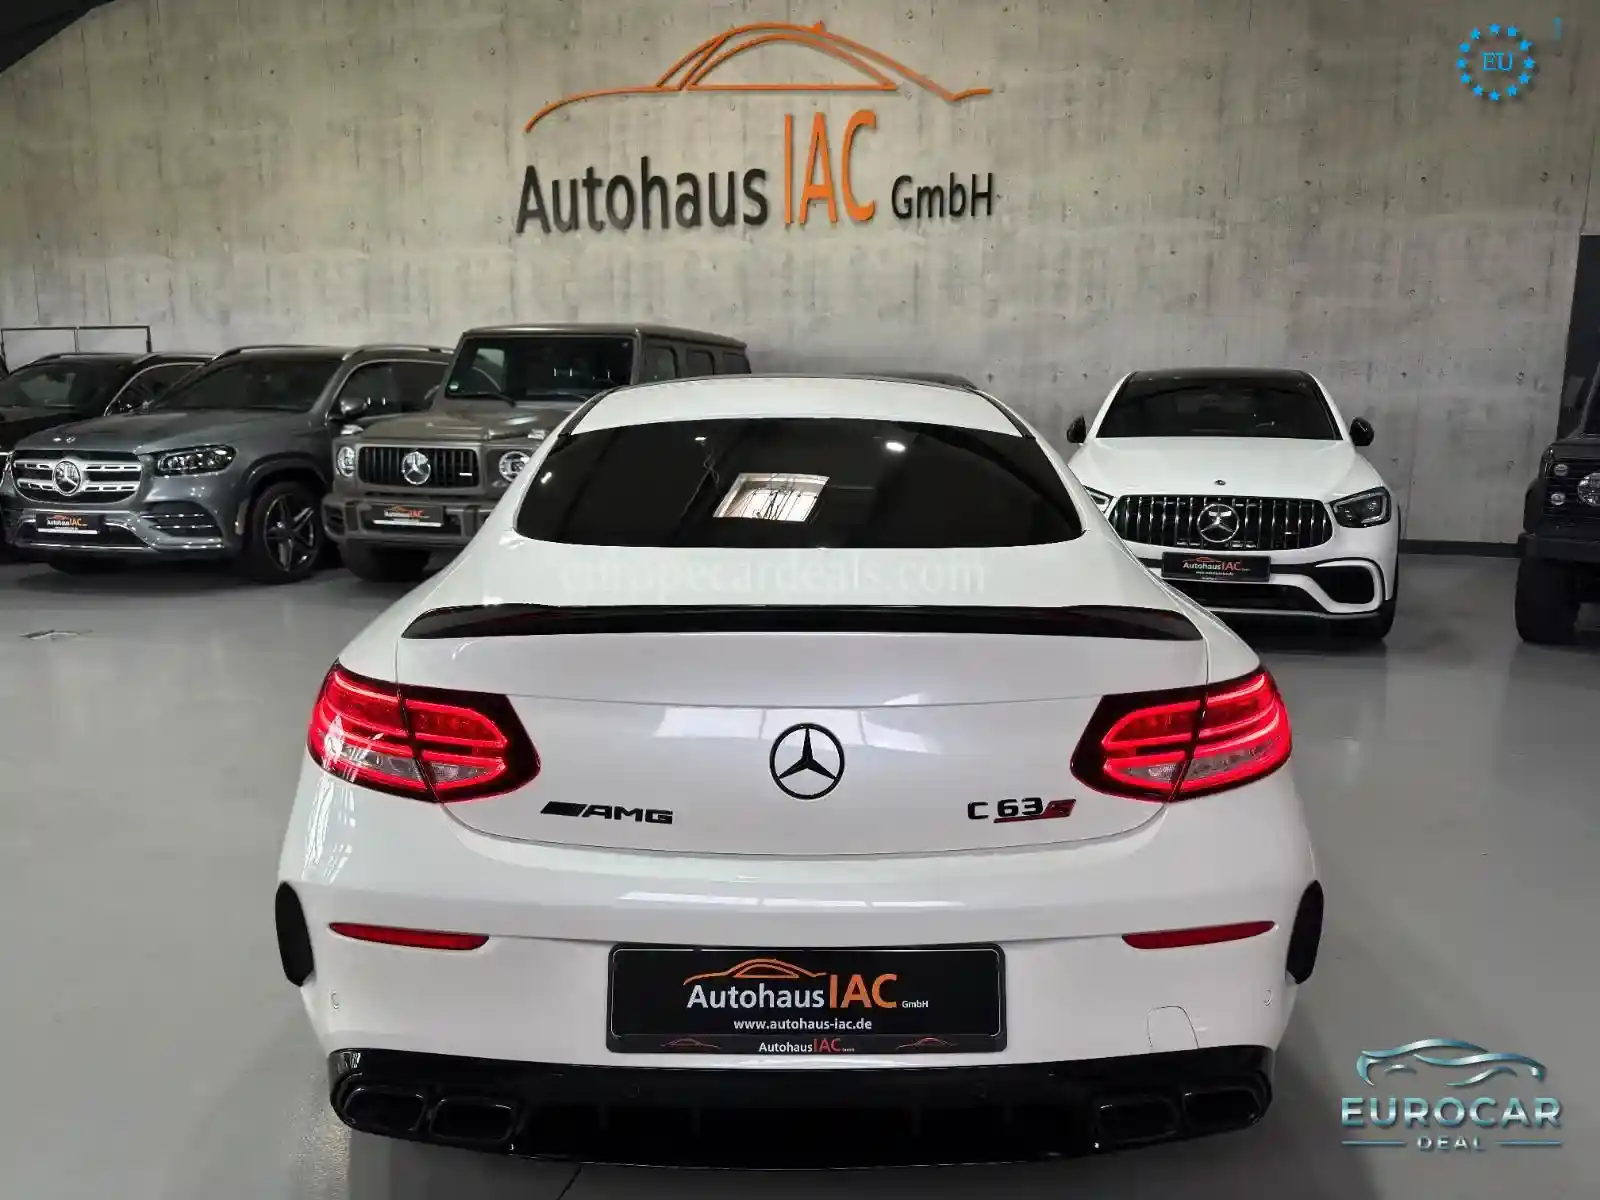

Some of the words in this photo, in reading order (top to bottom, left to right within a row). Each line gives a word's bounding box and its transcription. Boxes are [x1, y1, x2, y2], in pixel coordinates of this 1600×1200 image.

[516, 156, 769, 234] Autohaus
[784, 109, 877, 225] IAC
[891, 172, 994, 220] GmbH
[1182, 561, 1222, 570] Autohaus
[1221, 561, 1242, 571] IAC
[582, 804, 674, 825] AMG
[967, 801, 989, 820] C
[686, 983, 825, 1009] Autohaus
[829, 973, 898, 1009] IAC
[901, 1000, 929, 1009] GmbH
[733, 1018, 873, 1031] www.autohaus-iac.de
[759, 1042, 814, 1053] Autohaus
[813, 1038, 841, 1053] IAC
